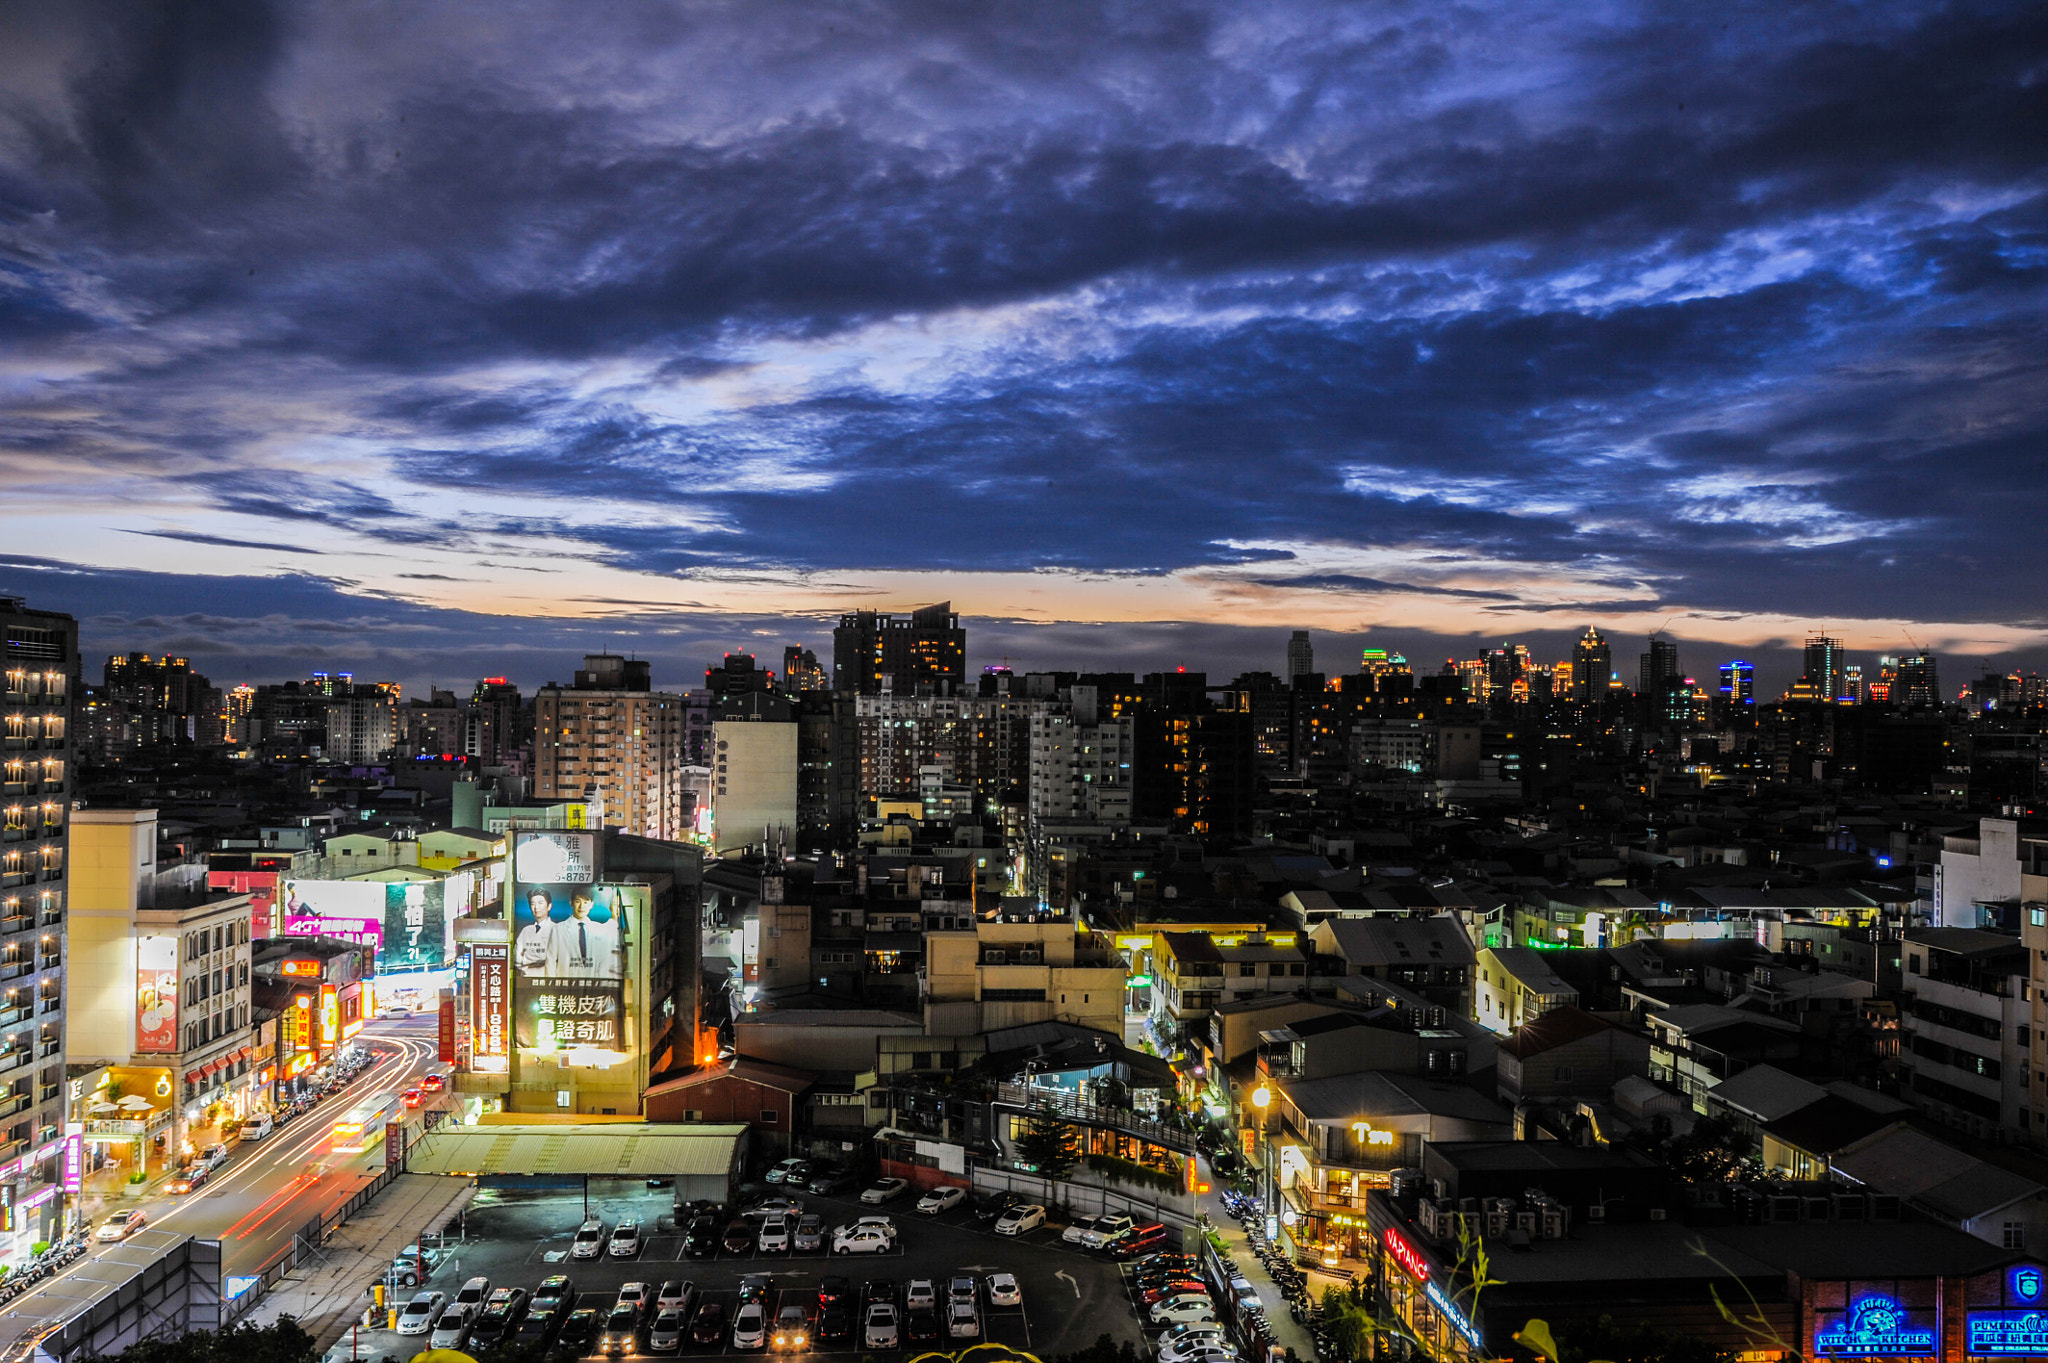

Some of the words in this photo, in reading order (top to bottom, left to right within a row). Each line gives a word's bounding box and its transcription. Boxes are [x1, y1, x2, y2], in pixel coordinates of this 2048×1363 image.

[538, 995, 616, 1016] 雙機皮秒
[1974, 1322, 2025, 1330] PUMPKIN
[1883, 1336, 1932, 1344] KITCHEN
